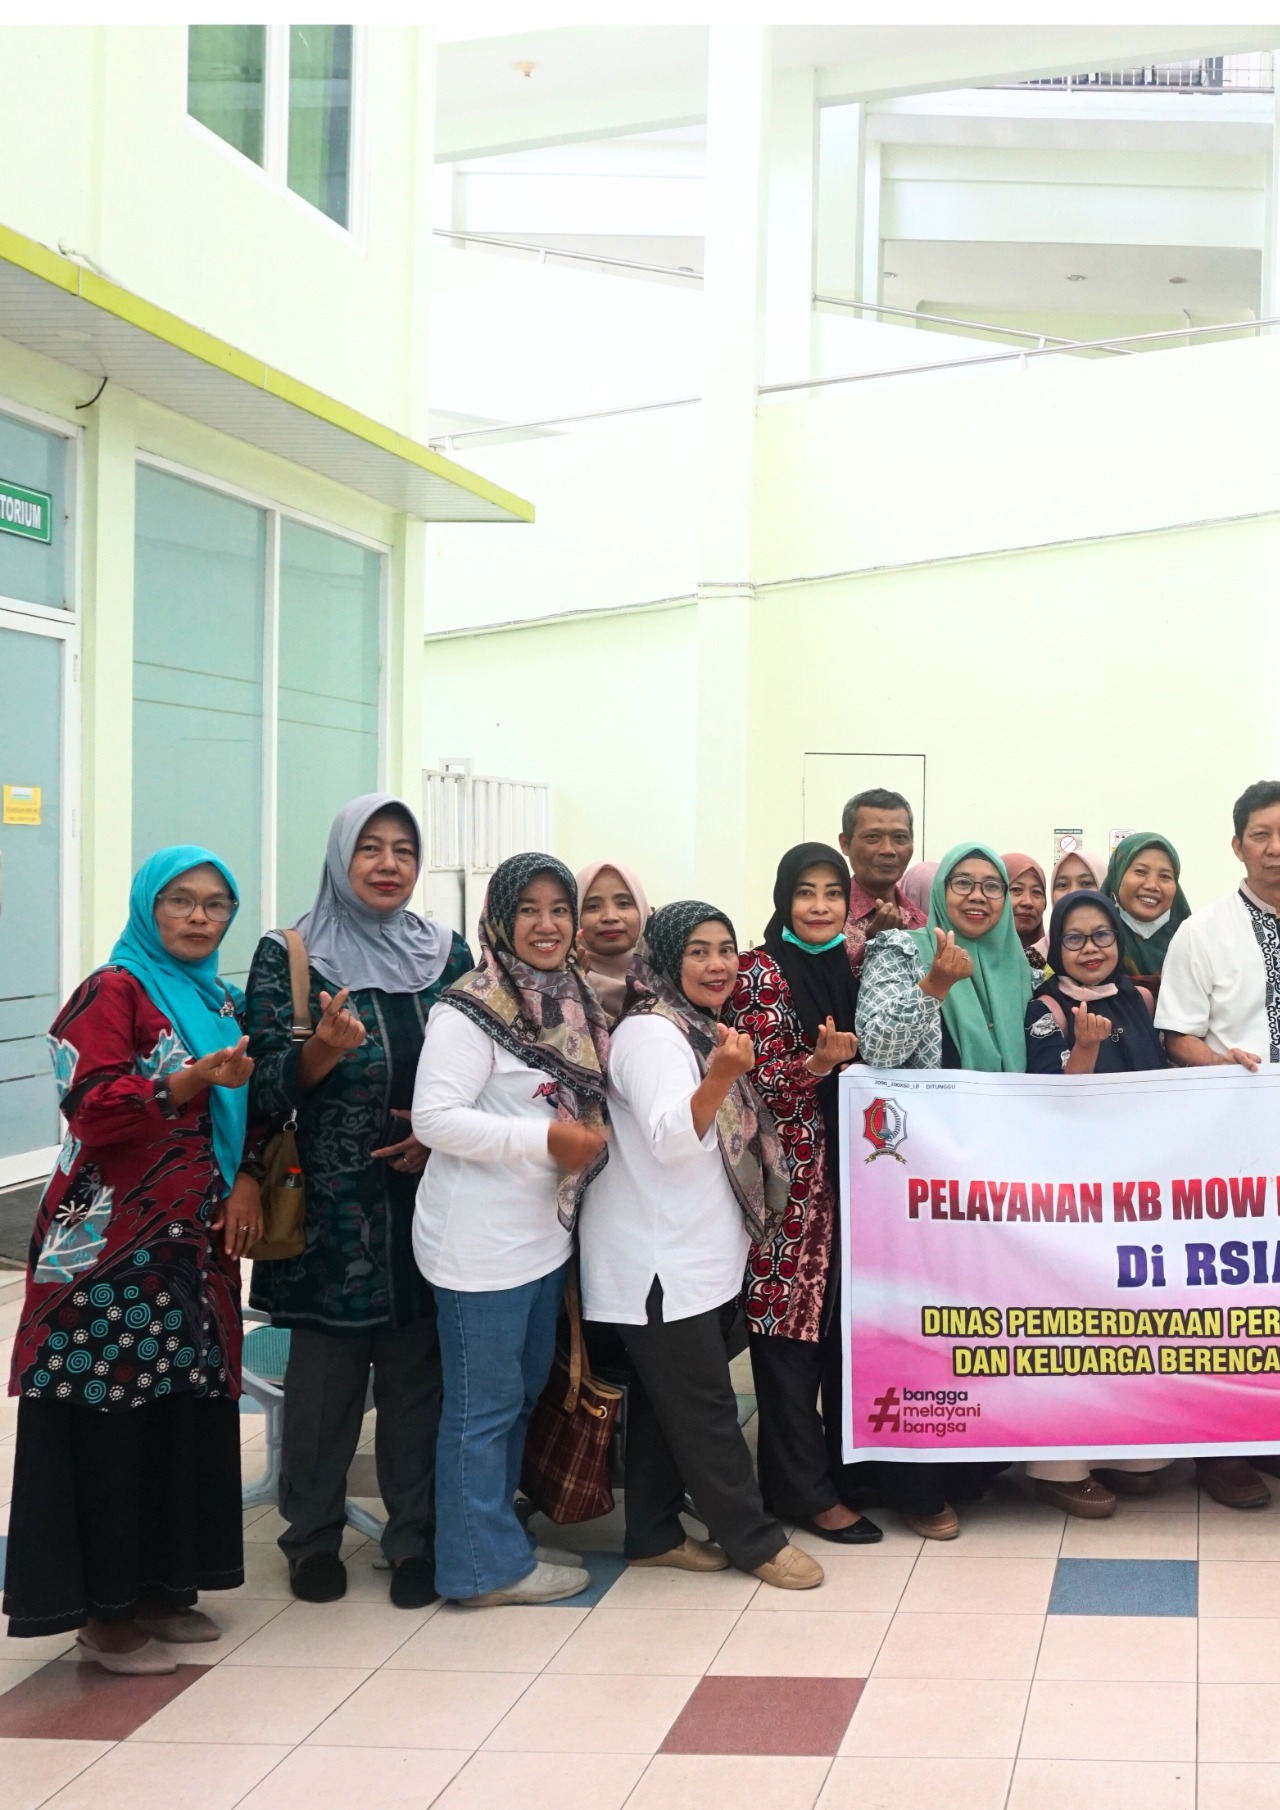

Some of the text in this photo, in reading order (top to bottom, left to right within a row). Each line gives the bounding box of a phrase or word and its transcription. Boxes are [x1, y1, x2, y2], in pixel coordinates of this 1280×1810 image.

[0, 494, 41, 530] TORIUM
[908, 1178, 1103, 1223] PELAYANAN
[1112, 1180, 1162, 1223] KB
[1172, 1176, 1268, 1221] MOW
[1116, 1243, 1167, 1288] Di
[921, 1306, 1003, 1337] DINAS
[1006, 1307, 1224, 1338] PEMBERDAYAAN
[952, 1346, 1010, 1377] DAN
[1013, 1345, 1154, 1377] KELUARGA
[903, 1387, 968, 1405] bangga
[903, 1403, 981, 1420] melayani
[903, 1419, 967, 1437] bangsa
